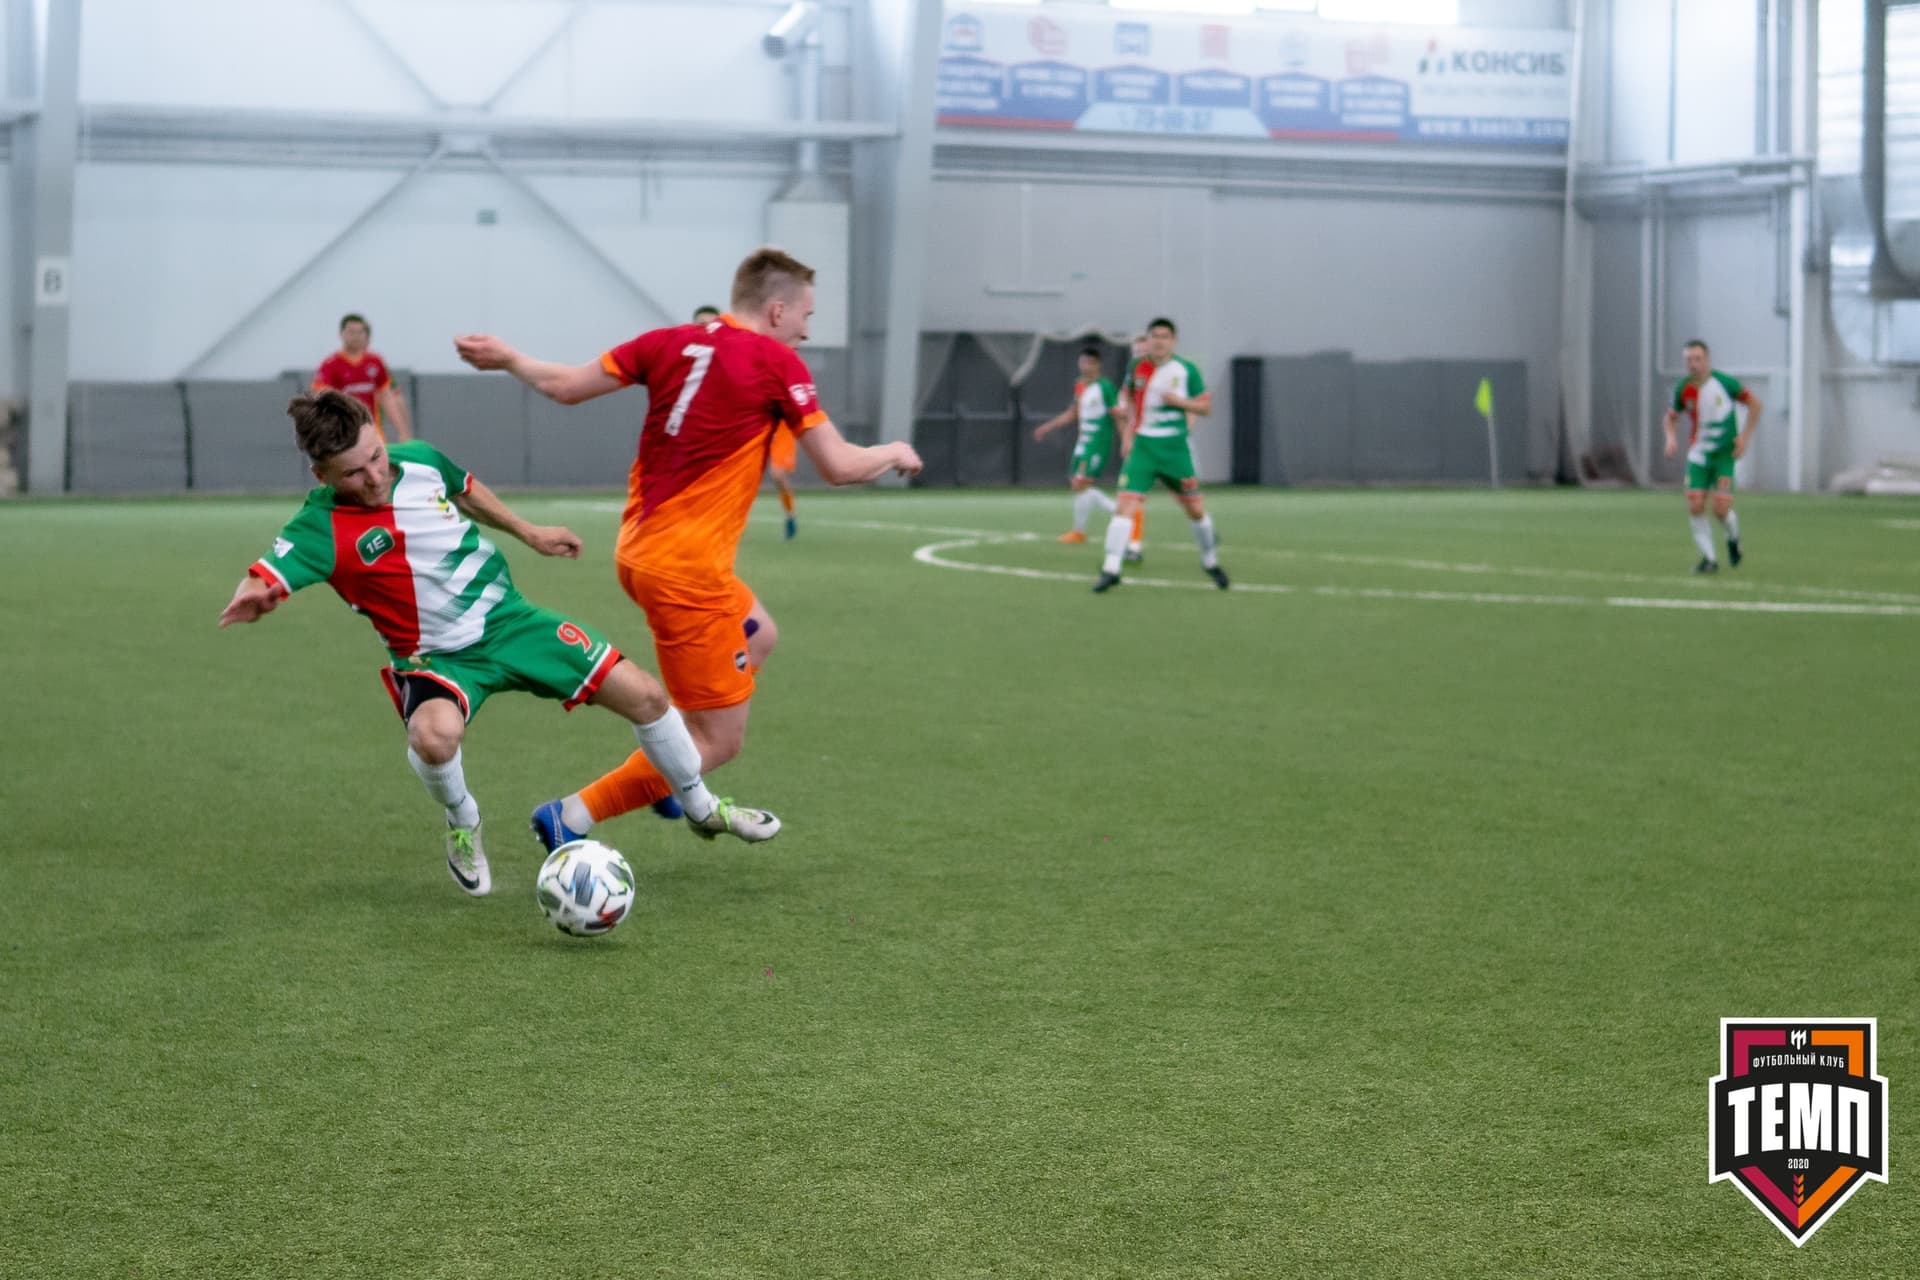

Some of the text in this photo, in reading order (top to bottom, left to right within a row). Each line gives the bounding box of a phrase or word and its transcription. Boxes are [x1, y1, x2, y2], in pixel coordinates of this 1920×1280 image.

[1452, 50, 1566, 76] КОНСИБ
[664, 343, 715, 436] 7
[557, 621, 593, 654] 9
